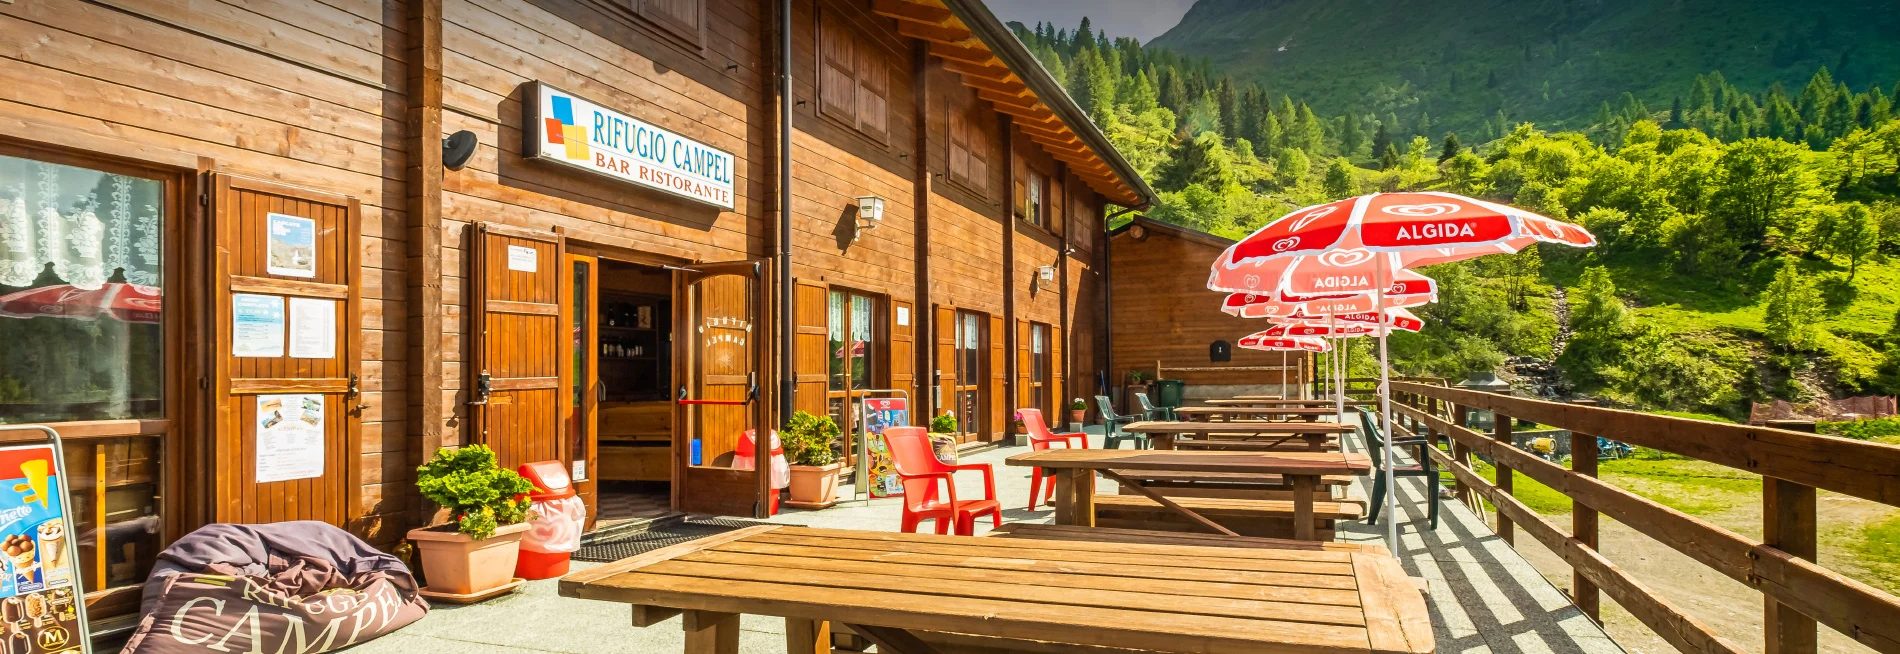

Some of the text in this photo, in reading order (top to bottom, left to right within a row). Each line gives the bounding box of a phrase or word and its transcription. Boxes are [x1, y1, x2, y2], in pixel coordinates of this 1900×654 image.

[593, 110, 730, 184] RIFUGIO CAMPEL
[595, 152, 729, 204] BAR RISTORANTE
[1396, 222, 1475, 241] ALGIDA
[1344, 313, 1376, 322] ALGIDA
[0, 505, 33, 525] netto
[170, 582, 402, 654] CAMPE
